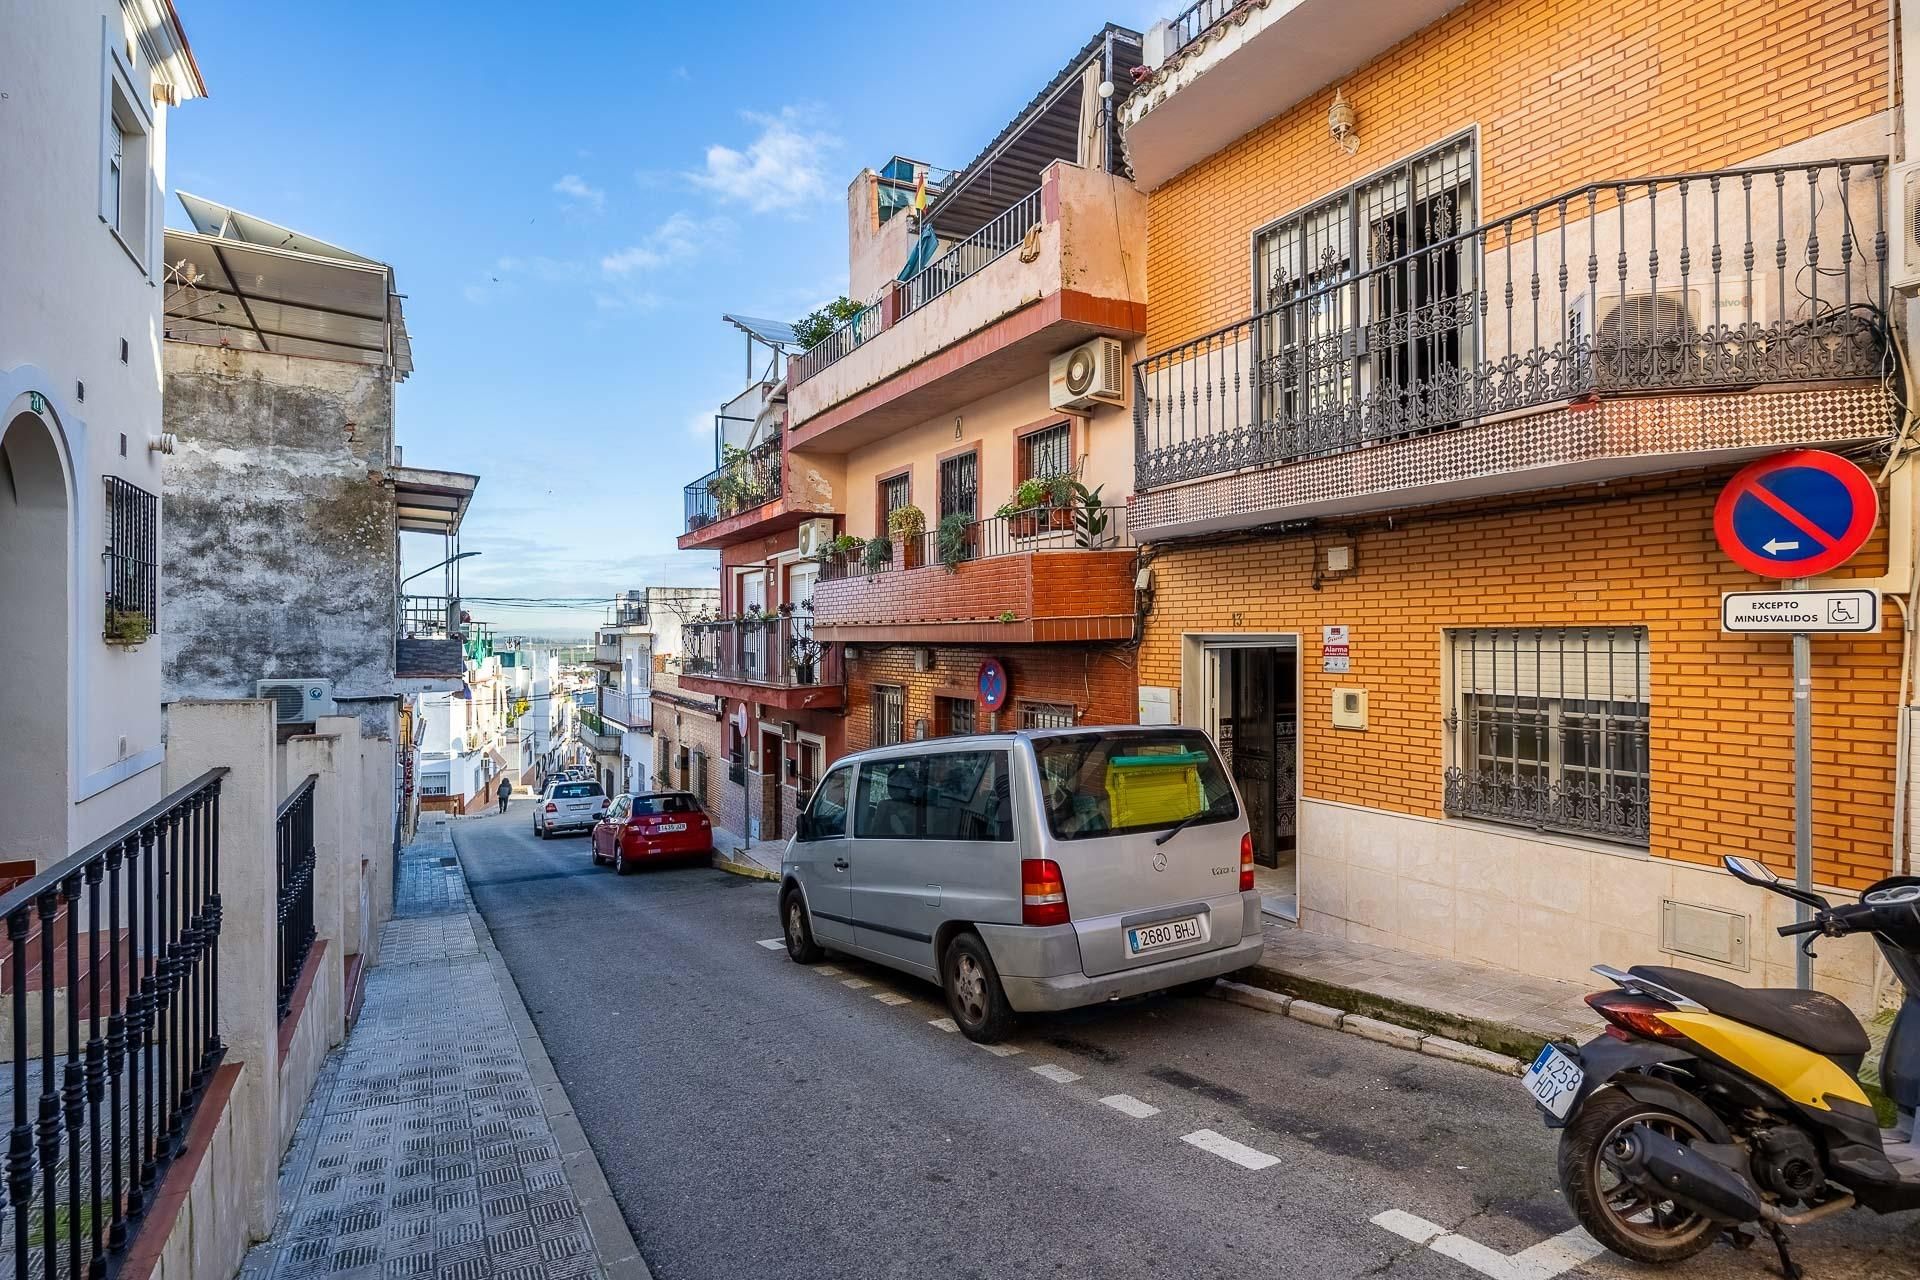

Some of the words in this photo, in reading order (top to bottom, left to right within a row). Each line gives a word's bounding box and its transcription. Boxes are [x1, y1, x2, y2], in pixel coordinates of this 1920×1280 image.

[1752, 601, 1799, 610] EXCEPTO
[1734, 614, 1818, 623] MINUSVALIDOS
[1211, 867, 1230, 876] Vito
[1140, 926, 1171, 947] 2680
[1173, 921, 1196, 940] BHJ
[1546, 1055, 1581, 1092] 4258
[1532, 1074, 1563, 1109] HDX
